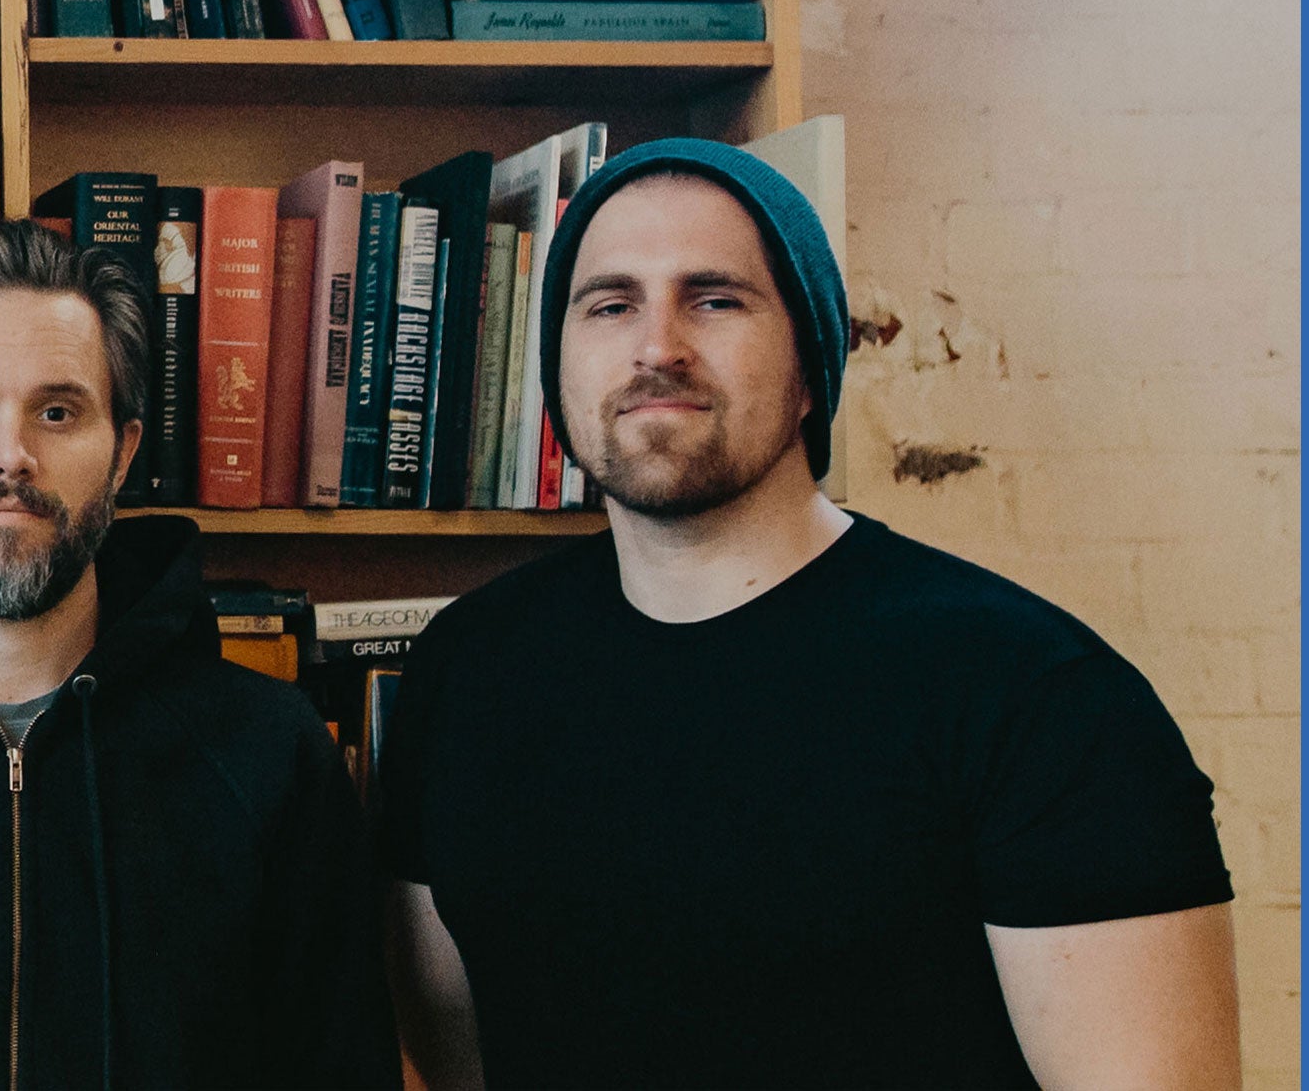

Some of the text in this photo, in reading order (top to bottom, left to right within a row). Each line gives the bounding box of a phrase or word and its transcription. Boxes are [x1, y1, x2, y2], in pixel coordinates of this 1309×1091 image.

[93, 194, 145, 203] WILL DURANT
[106, 211, 128, 220] OUR
[93, 222, 142, 231] ORIENTAL
[368, 203, 382, 256] HUMAN
[93, 233, 142, 244] HERITAGE
[221, 237, 258, 249] MAJOR
[218, 264, 260, 274] BRITISH
[215, 288, 261, 300] WRITERS
[358, 321, 374, 406] INADEQUACY
[392, 313, 430, 403] BACKSTAGE
[387, 410, 423, 473] PASSES
[333, 610, 412, 628] THE AGE OF
[353, 641, 402, 656] GREAT
